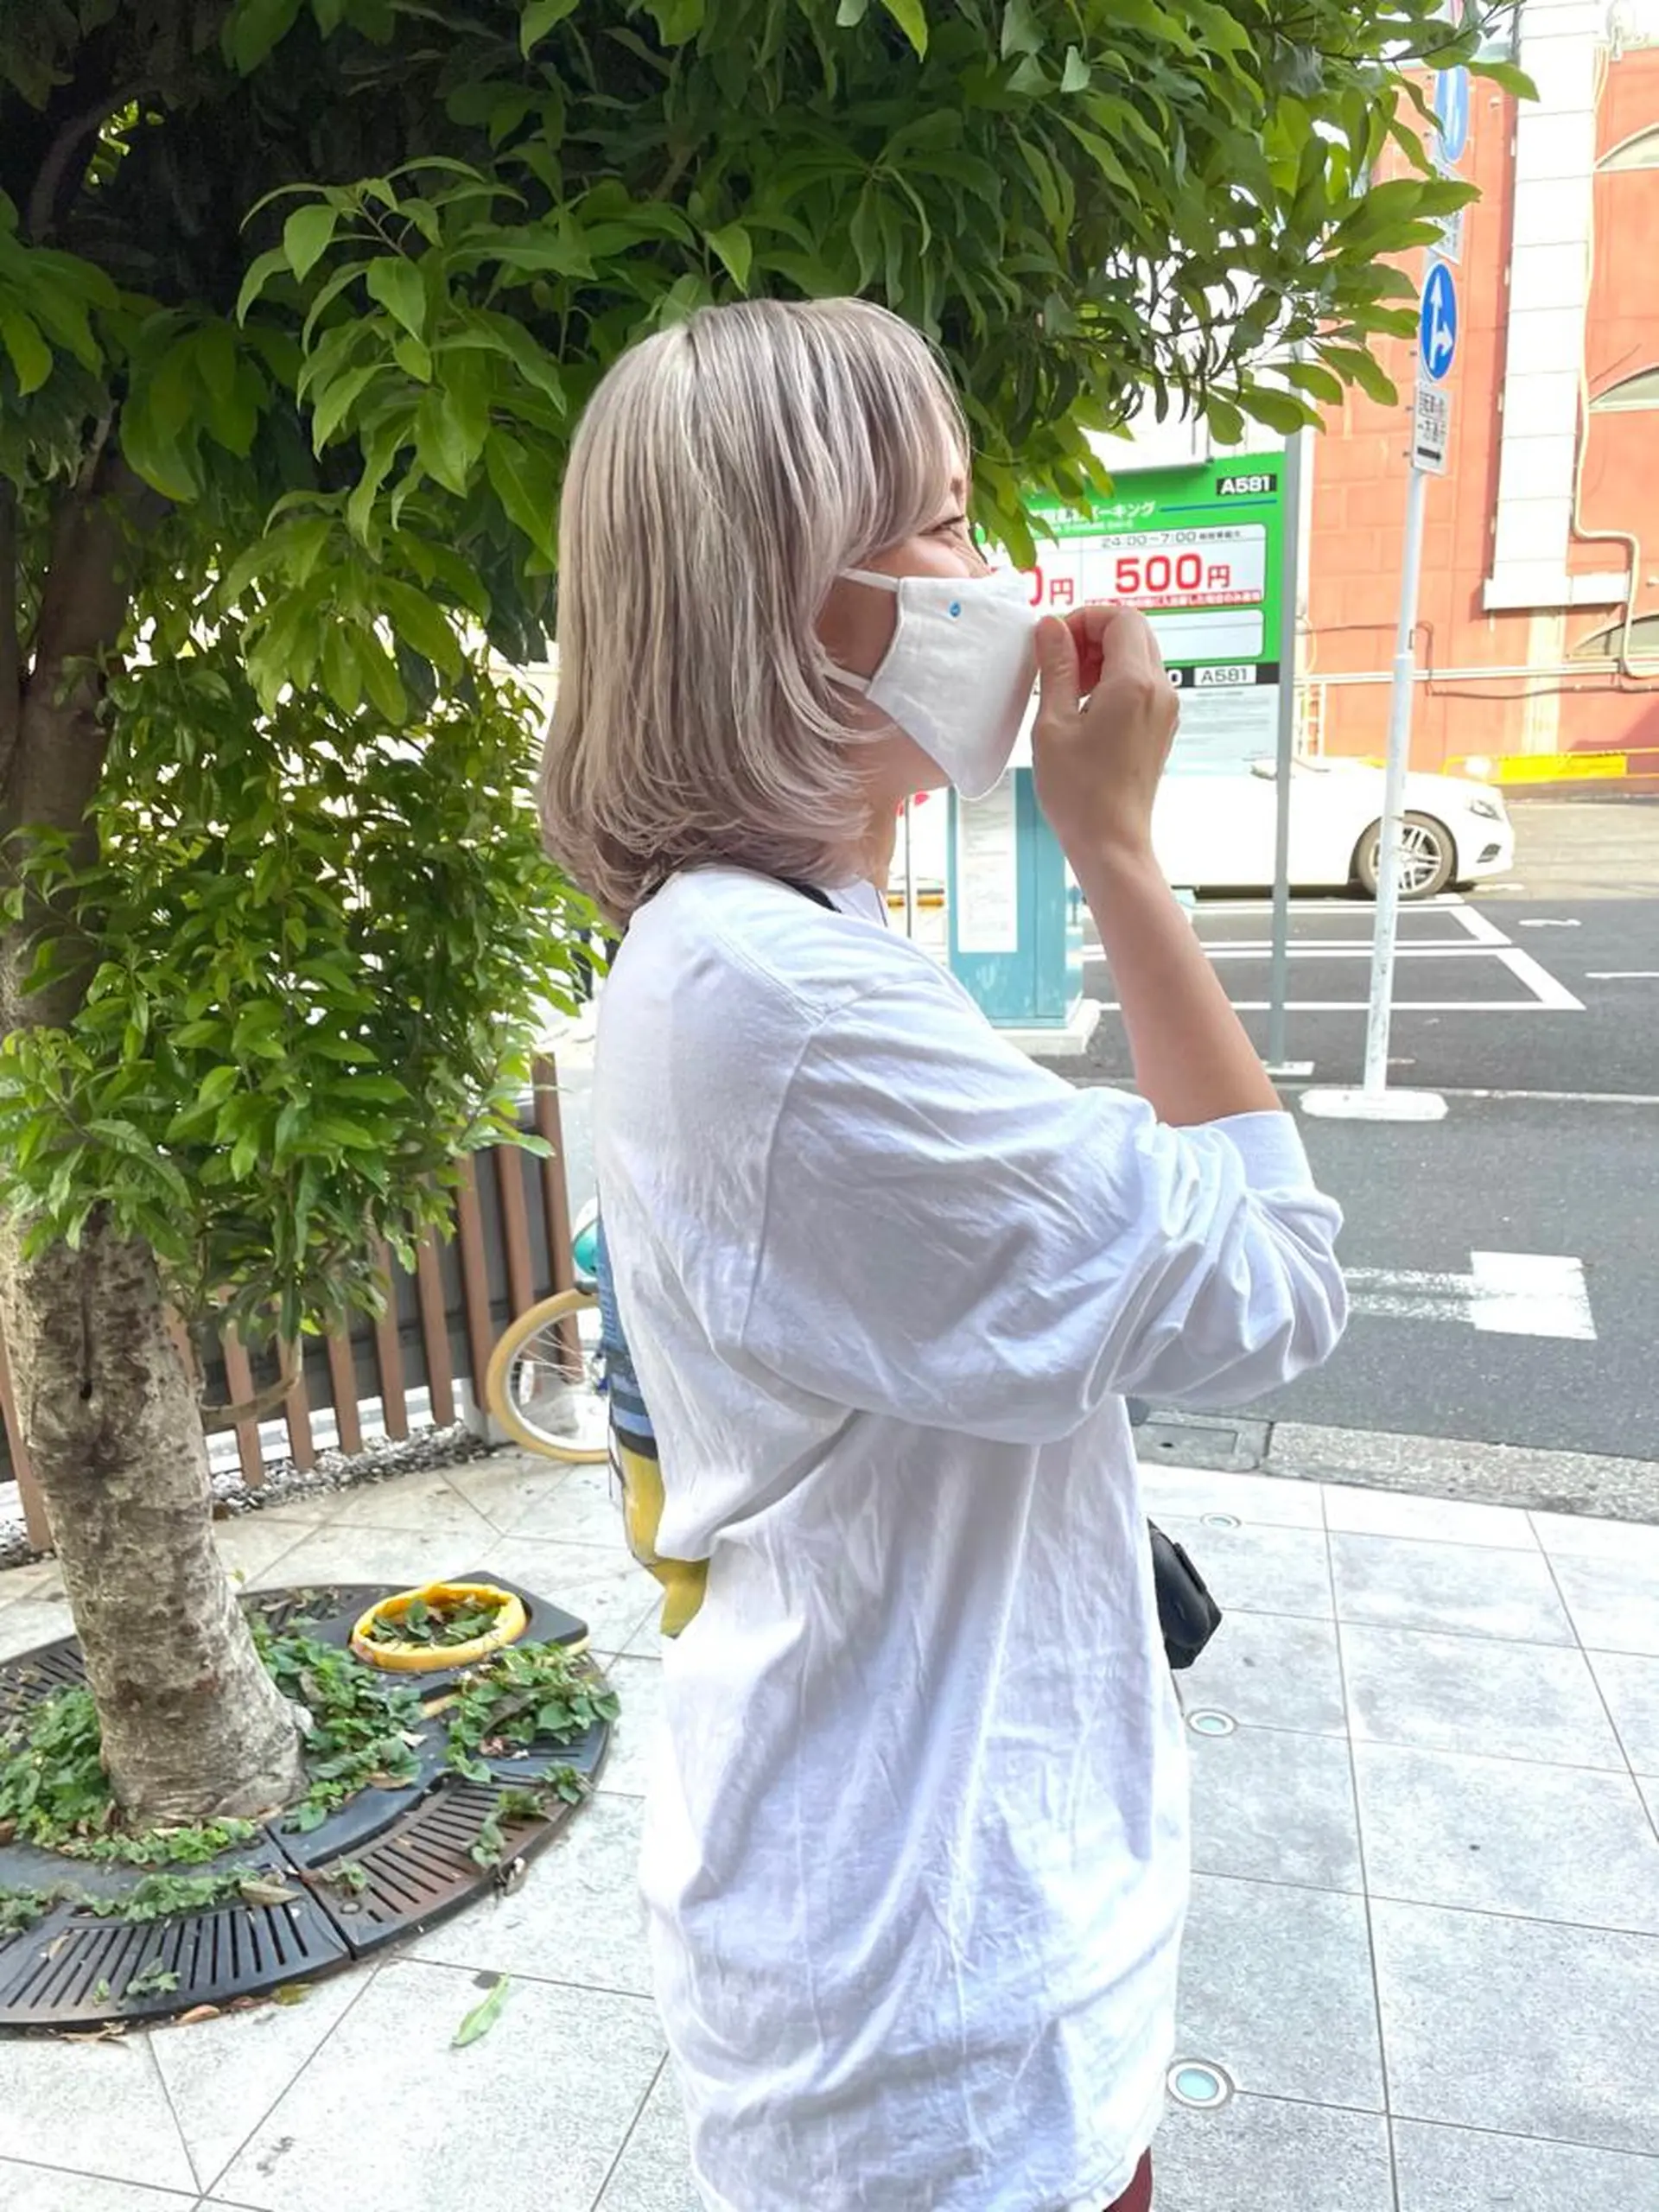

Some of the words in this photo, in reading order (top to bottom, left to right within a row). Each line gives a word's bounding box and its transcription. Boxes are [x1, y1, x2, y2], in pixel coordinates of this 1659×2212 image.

[1220, 475, 1272, 495] A581
[1116, 553, 1230, 594] 500円
[1200, 667, 1248, 684] A581
